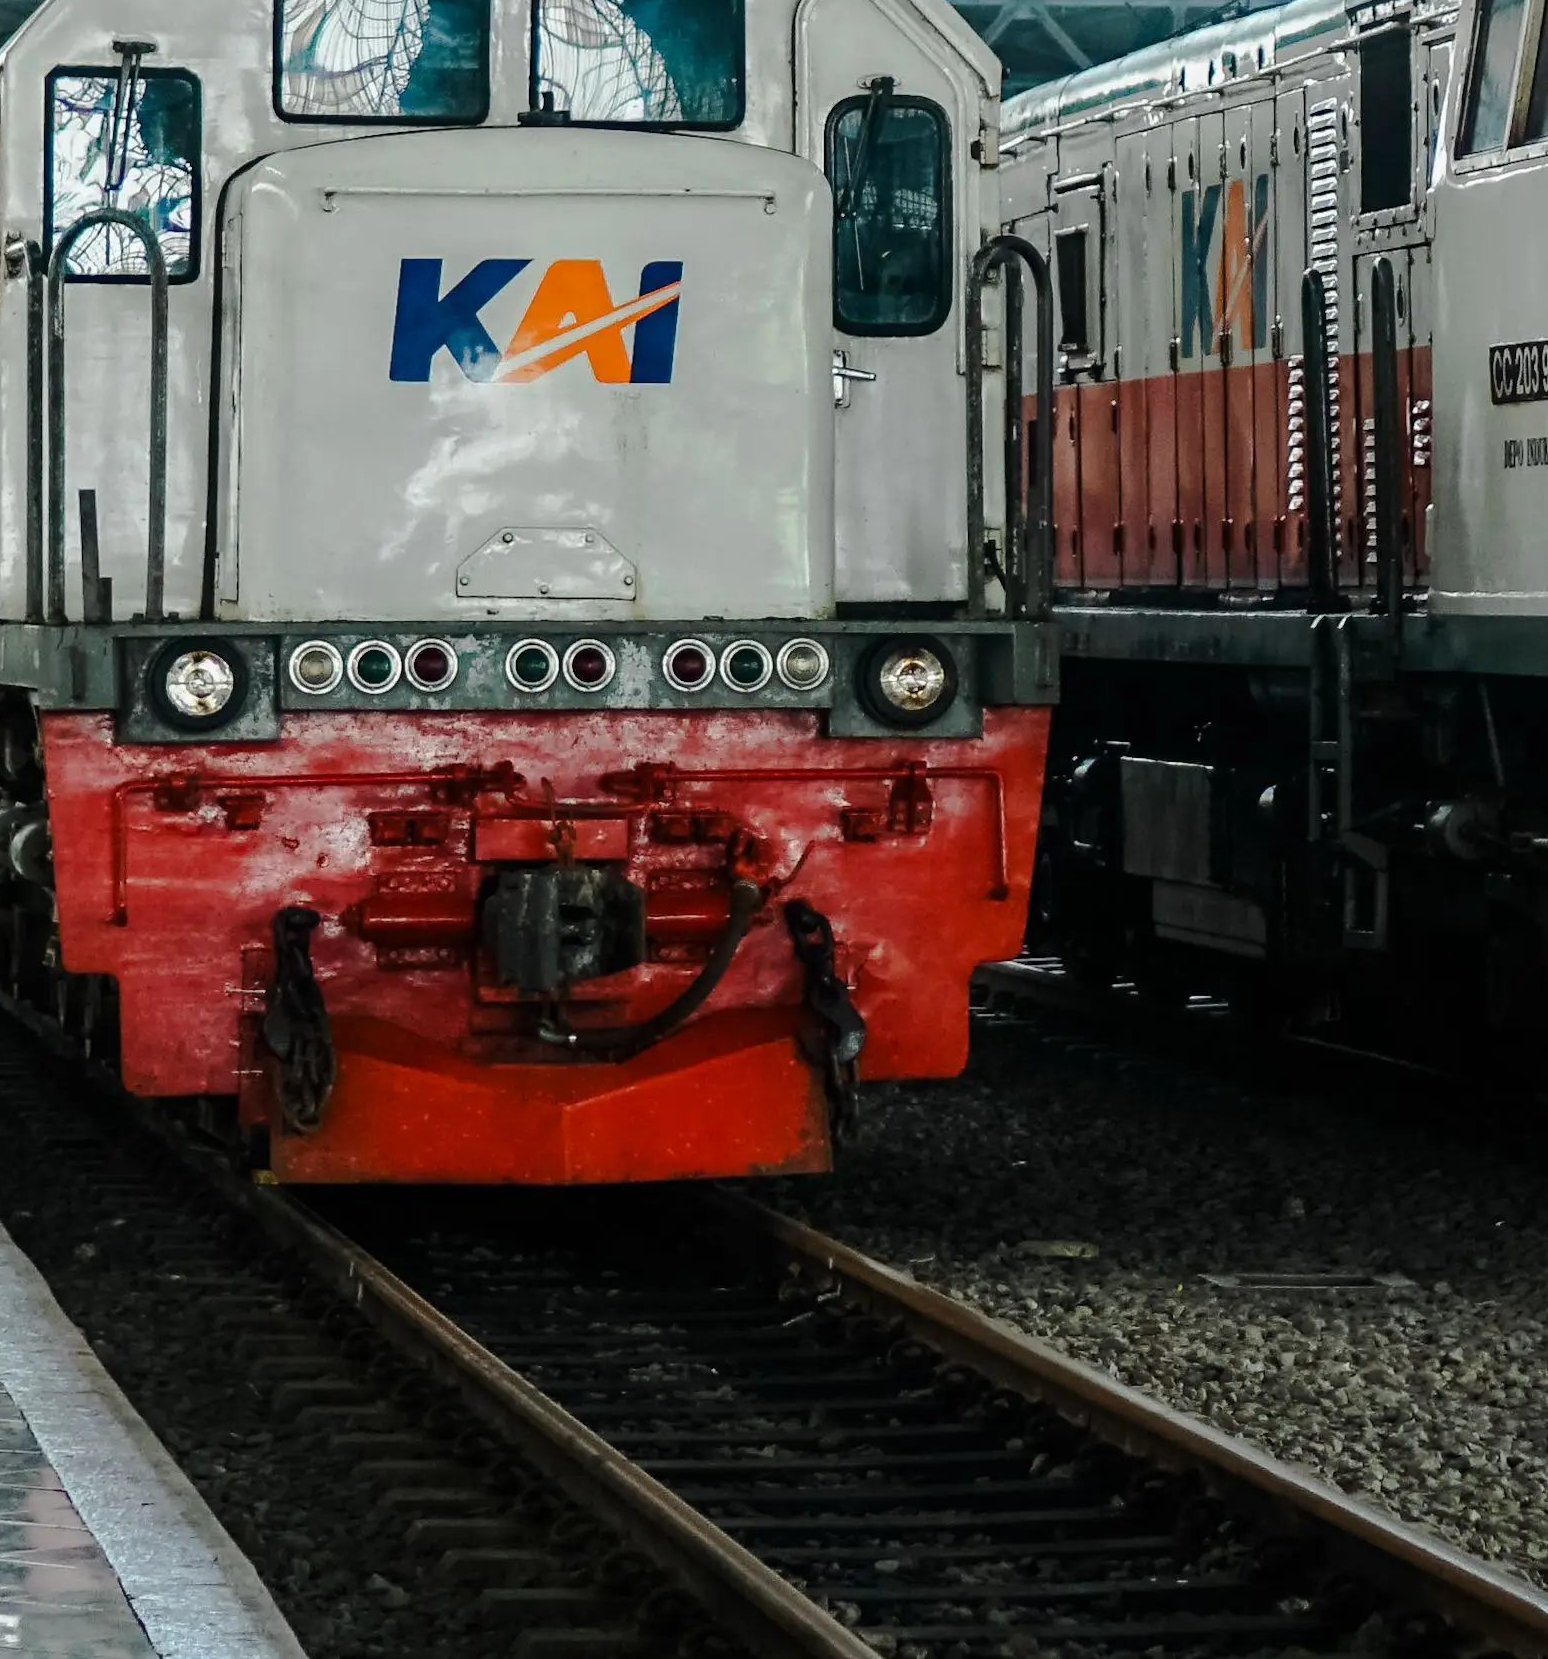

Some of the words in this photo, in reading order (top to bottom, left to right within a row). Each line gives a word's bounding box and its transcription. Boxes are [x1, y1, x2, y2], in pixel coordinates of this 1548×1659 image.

[389, 258, 684, 383] KAI
[1181, 173, 1269, 359] KAI
[1493, 349, 1513, 398] CC
[1515, 346, 1539, 395] 203
